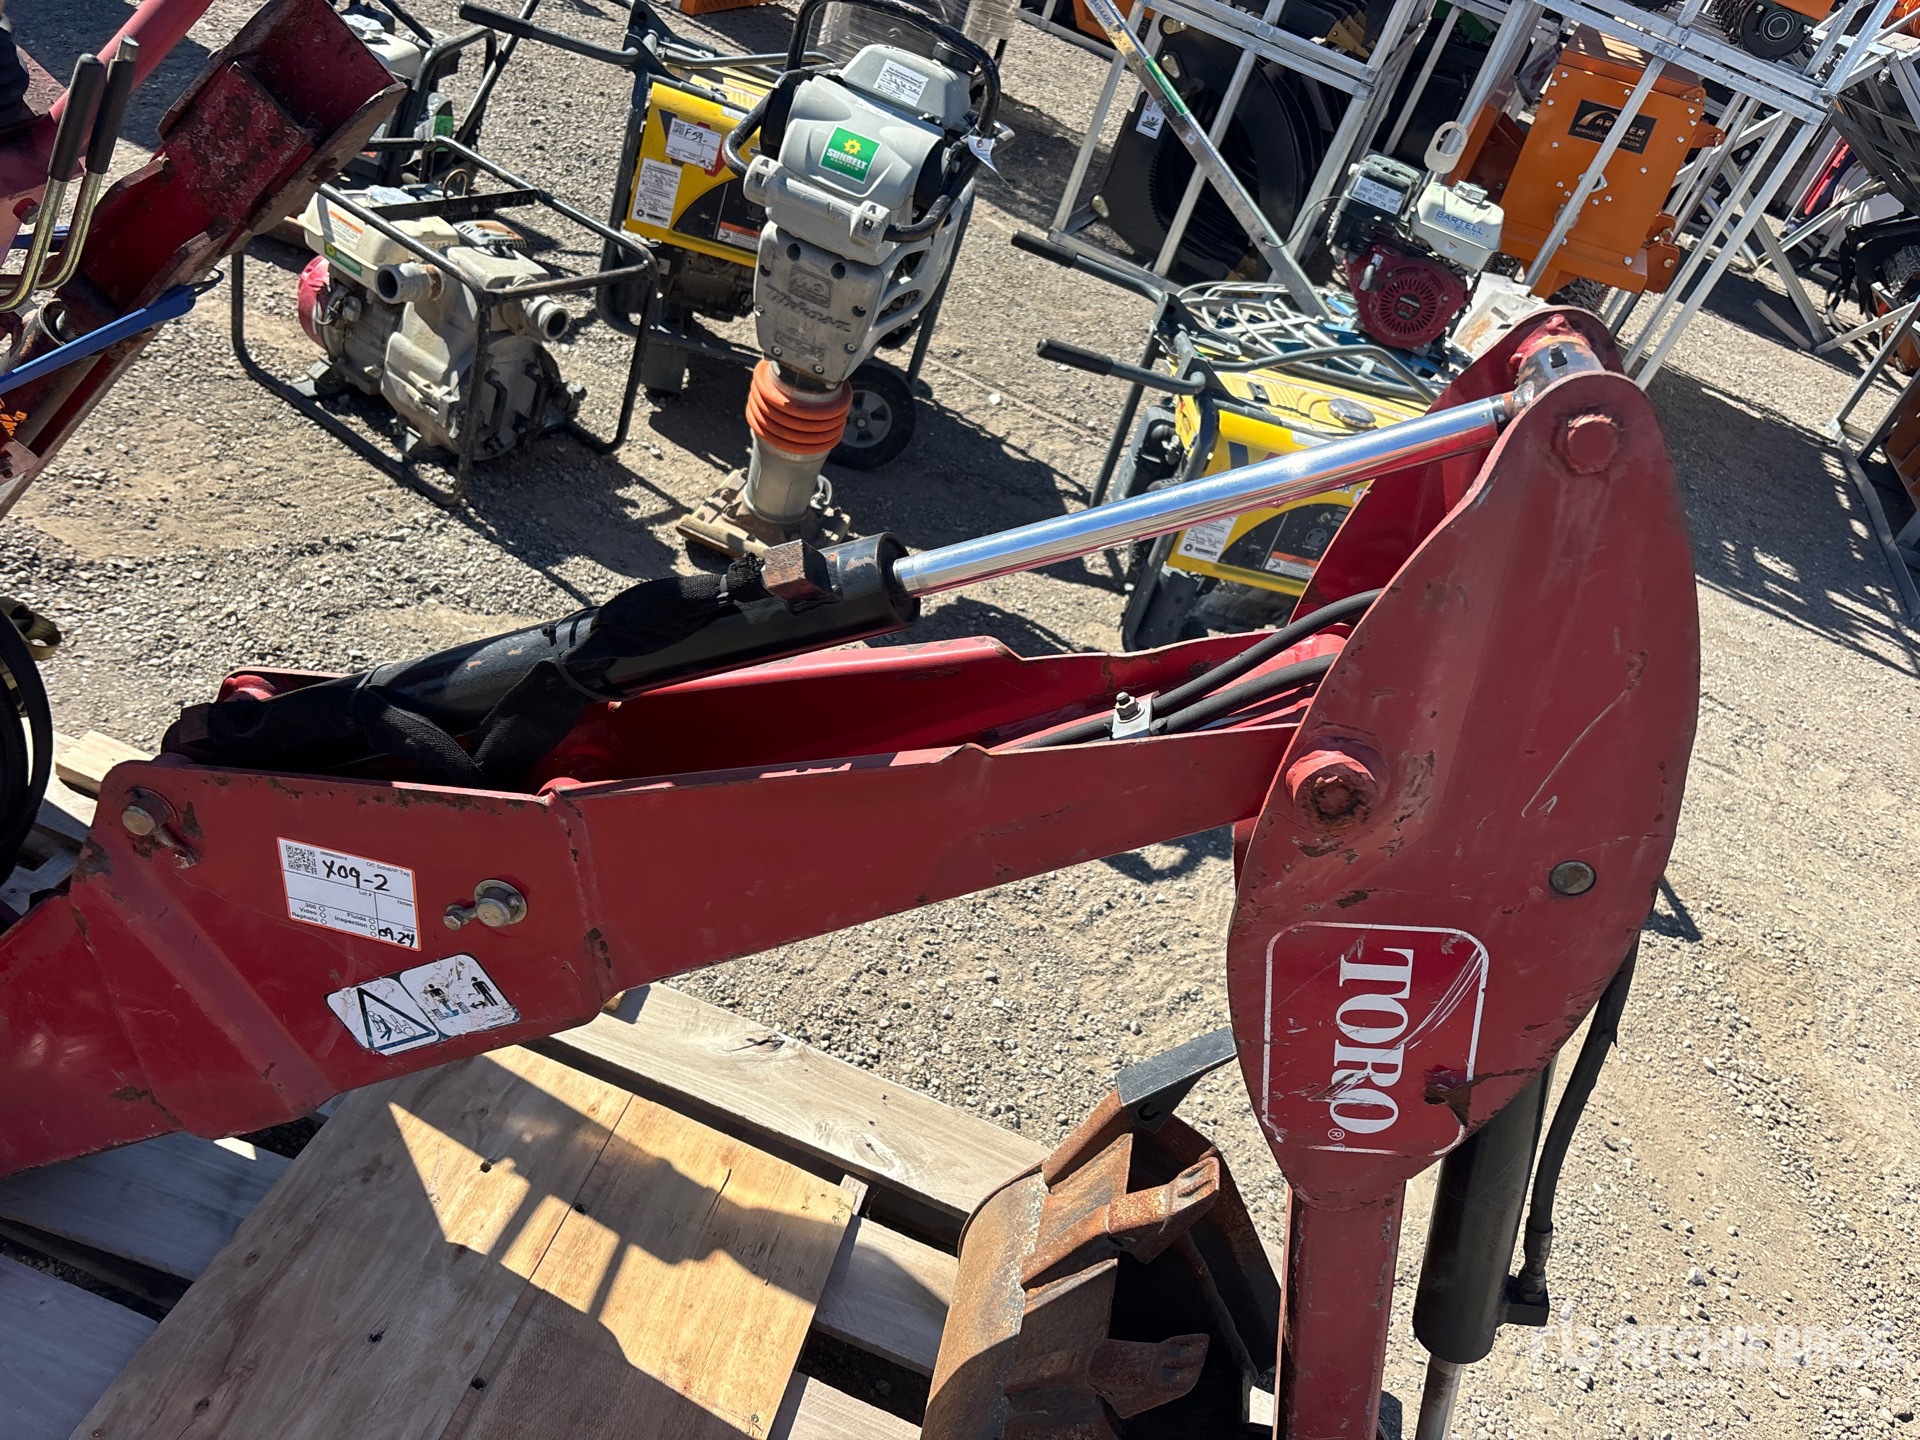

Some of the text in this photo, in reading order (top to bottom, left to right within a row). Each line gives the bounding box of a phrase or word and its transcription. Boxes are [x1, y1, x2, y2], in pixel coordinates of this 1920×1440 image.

[1595, 118, 1647, 137] ARER
[826, 147, 868, 170] SUNBELT
[1436, 209, 1484, 236] BARTELL
[291, 911, 319, 922] Rephoto
[298, 906, 318, 916] Video
[346, 912, 367, 922] Fluids
[334, 915, 368, 929] Inspection
[1329, 947, 1414, 1135] TORO
